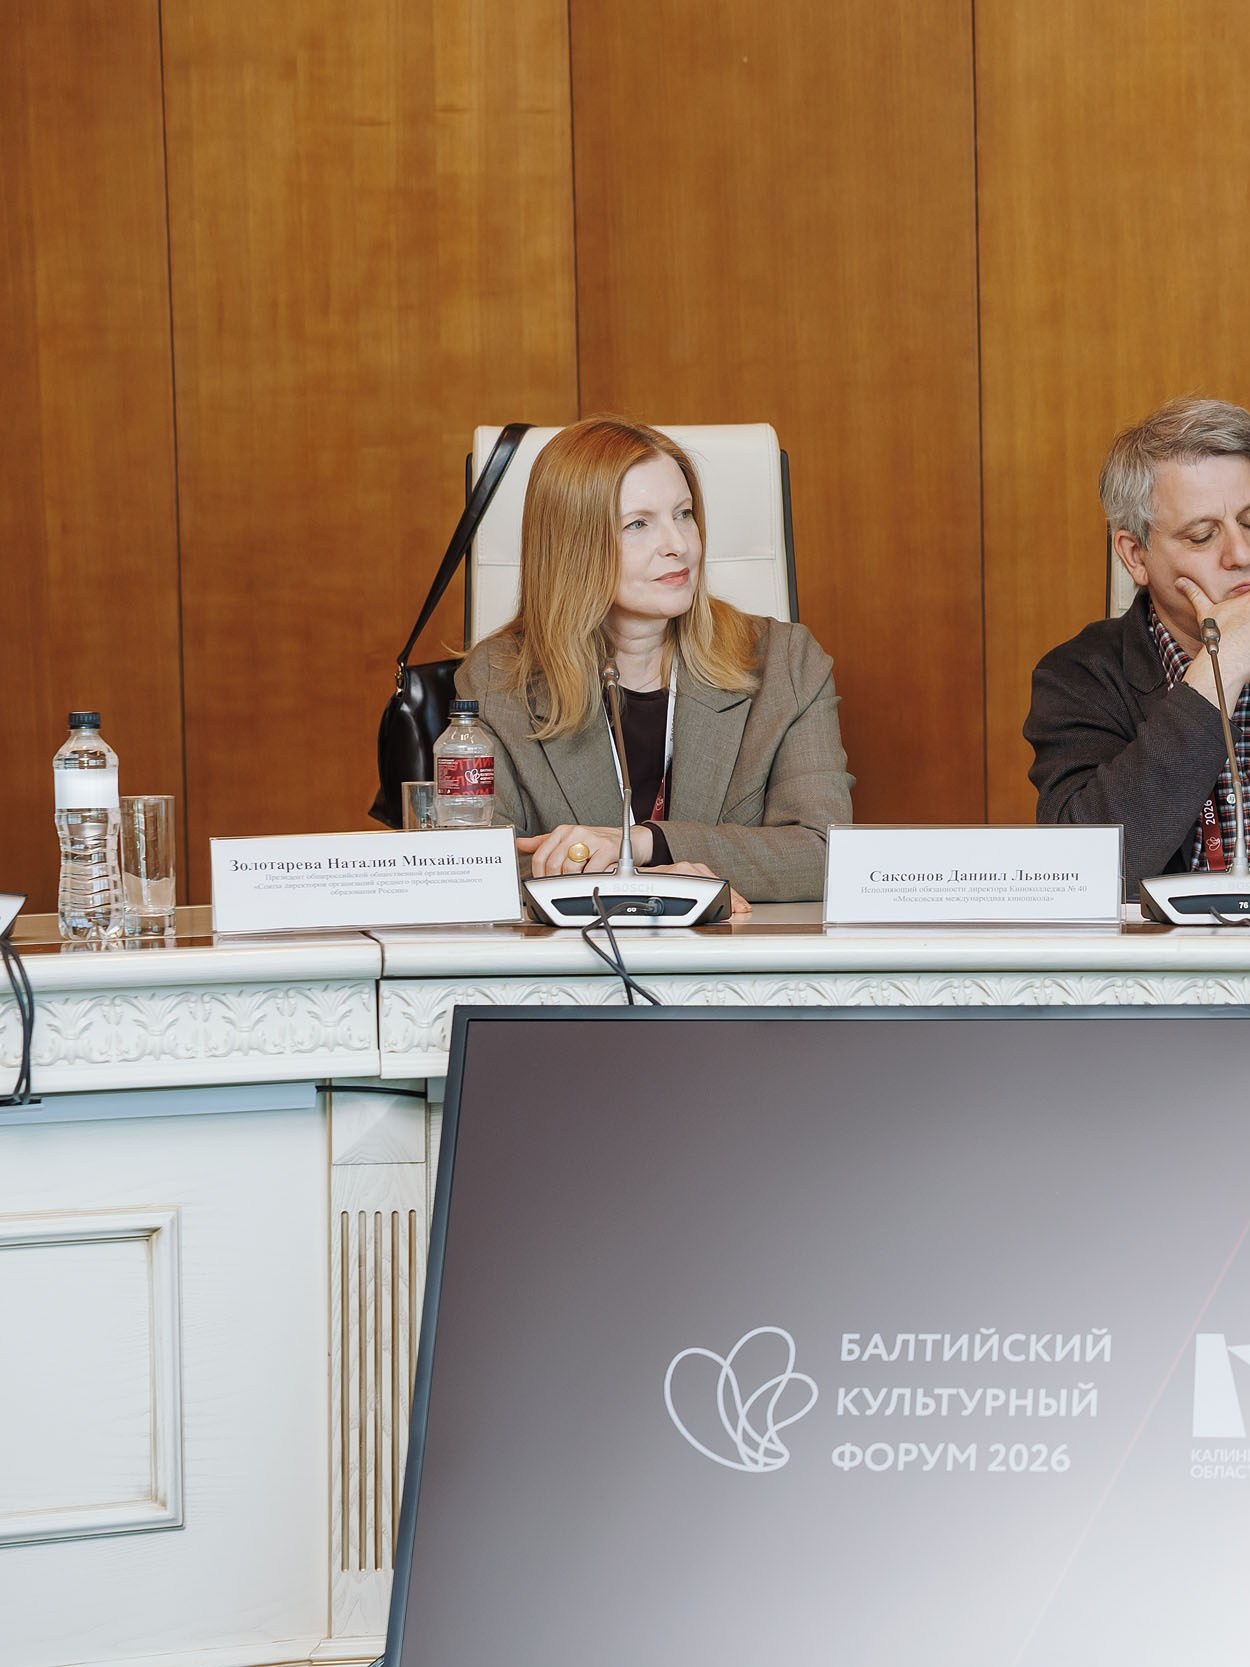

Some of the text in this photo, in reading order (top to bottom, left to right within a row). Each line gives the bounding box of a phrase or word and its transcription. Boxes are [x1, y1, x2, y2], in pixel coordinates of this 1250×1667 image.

[1203, 799, 1216, 825] 2026
[230, 854, 503, 873] Золотарева Наталия Михайловна
[265, 873, 304, 882] Президент
[869, 869, 1080, 883] Саксонов Даниил Львович
[861, 886, 917, 894] Исполняющий
[968, 886, 1007, 894] директора
[1009, 885, 1066, 893] Киноколледжа
[893, 895, 944, 903] «Московская
[945, 895, 1005, 904] международная
[1239, 901, 1249, 909] 76
[840, 1327, 1113, 1363] БАЛТИЙСКИЙ
[836, 1381, 1099, 1418] КУЛЬТУРНЫЙ
[831, 1441, 1071, 1473] ФОРУМ 2026
